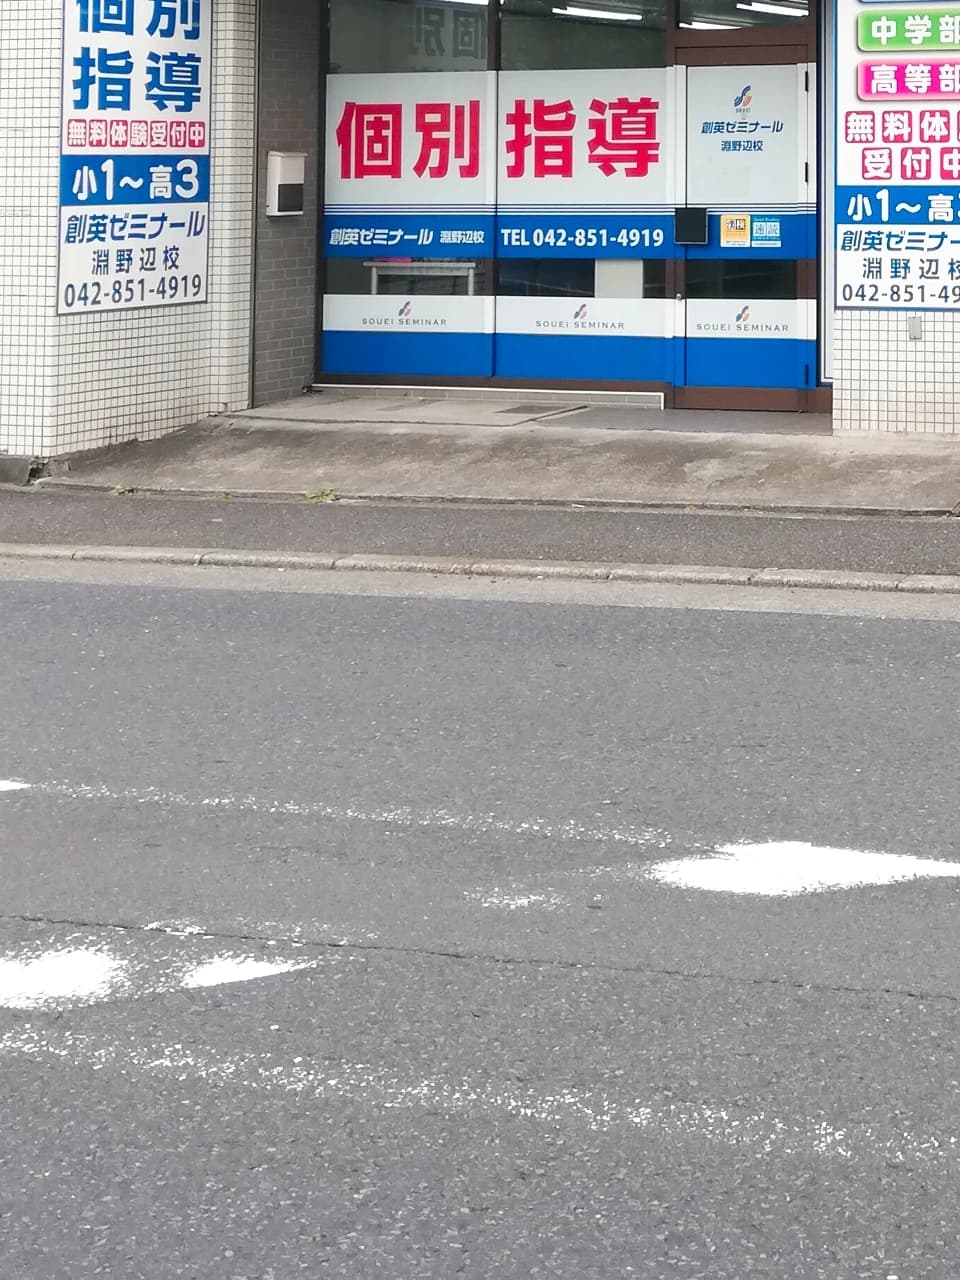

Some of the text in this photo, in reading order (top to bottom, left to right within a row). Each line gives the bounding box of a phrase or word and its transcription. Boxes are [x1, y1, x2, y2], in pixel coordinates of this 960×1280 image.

[72, 47, 202, 113] 指導
[68, 120, 205, 147] 無料体験受付中
[336, 97, 661, 180] 個別指導
[701, 120, 784, 134] 創英ゼミナール
[64, 211, 206, 244] 創英ゼミナール
[329, 228, 434, 246] 創英ゼミナール
[501, 228, 530, 246] TEL
[533, 228, 664, 247] 042-851-4919
[91, 245, 180, 276] 淵野辺校
[64, 274, 202, 308] 042-851-4919
[362, 317, 447, 326] SOUEI SEMINAR
[696, 323, 789, 332] SOUEI SEMINAR
